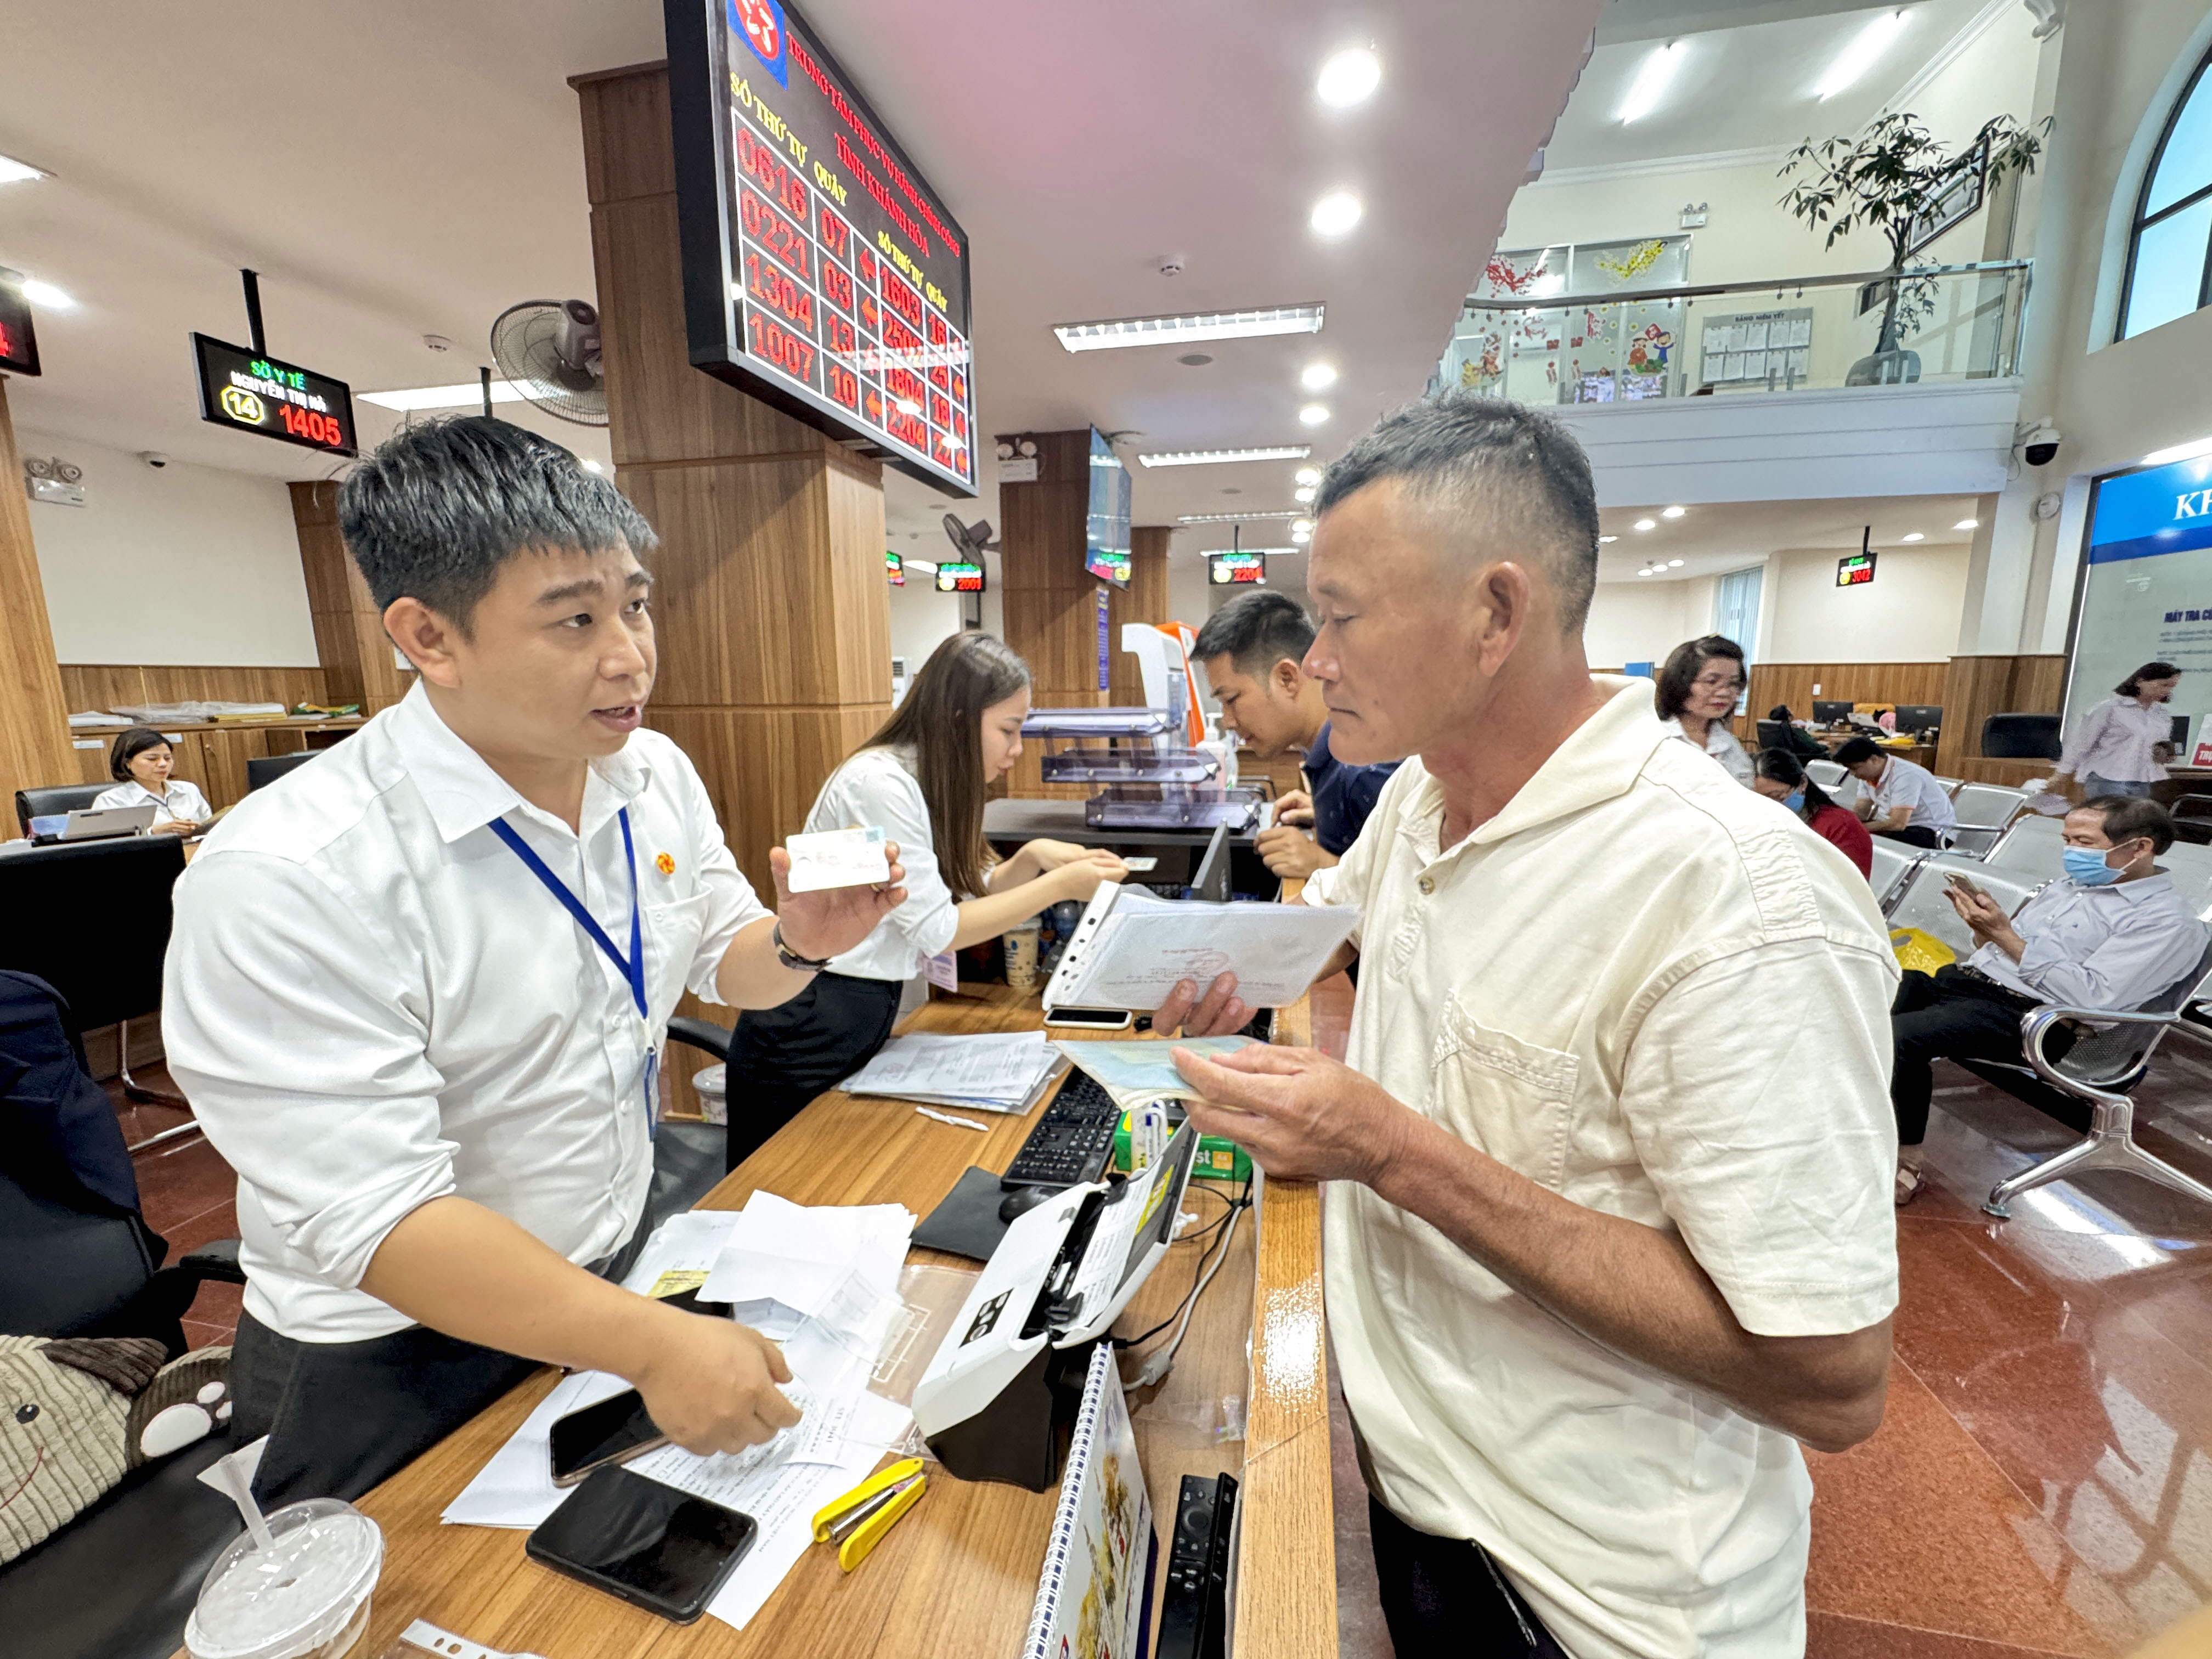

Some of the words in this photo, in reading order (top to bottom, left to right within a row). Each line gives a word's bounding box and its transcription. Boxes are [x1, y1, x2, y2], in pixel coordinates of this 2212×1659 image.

[730, 72, 752, 108] SỐ
[753, 95, 787, 142] THỨ
[787, 131, 808, 167] TỰ
[814, 161, 848, 206] QUẦY
[786, 30, 828, 95] TRUNG
[829, 84, 854, 127] TÂM
[854, 115, 880, 159] PHỤC
[880, 149, 894, 178] VỤ
[738, 127, 808, 222] 0616
[821, 207, 848, 257] 07
[834, 132, 866, 186] TỈNH
[866, 170, 907, 233] KHÁNH
[907, 218, 930, 258] HÒA
[741, 189, 810, 279] 0221
[823, 260, 851, 310] 03
[878, 230, 891, 254] SỐ
[746, 253, 812, 332] 1304
[827, 314, 854, 359] 13
[880, 266, 921, 327] 1603
[230, 371, 285, 400] NGUYỄN
[251, 360, 271, 379] SỞ
[274, 369, 285, 383] Y
[287, 373, 306, 390] TẾ
[748, 313, 814, 381] 1007
[829, 365, 856, 408] 10
[229, 392, 258, 419] 14
[279, 404, 342, 446] 1405
[932, 393, 949, 428] 18
